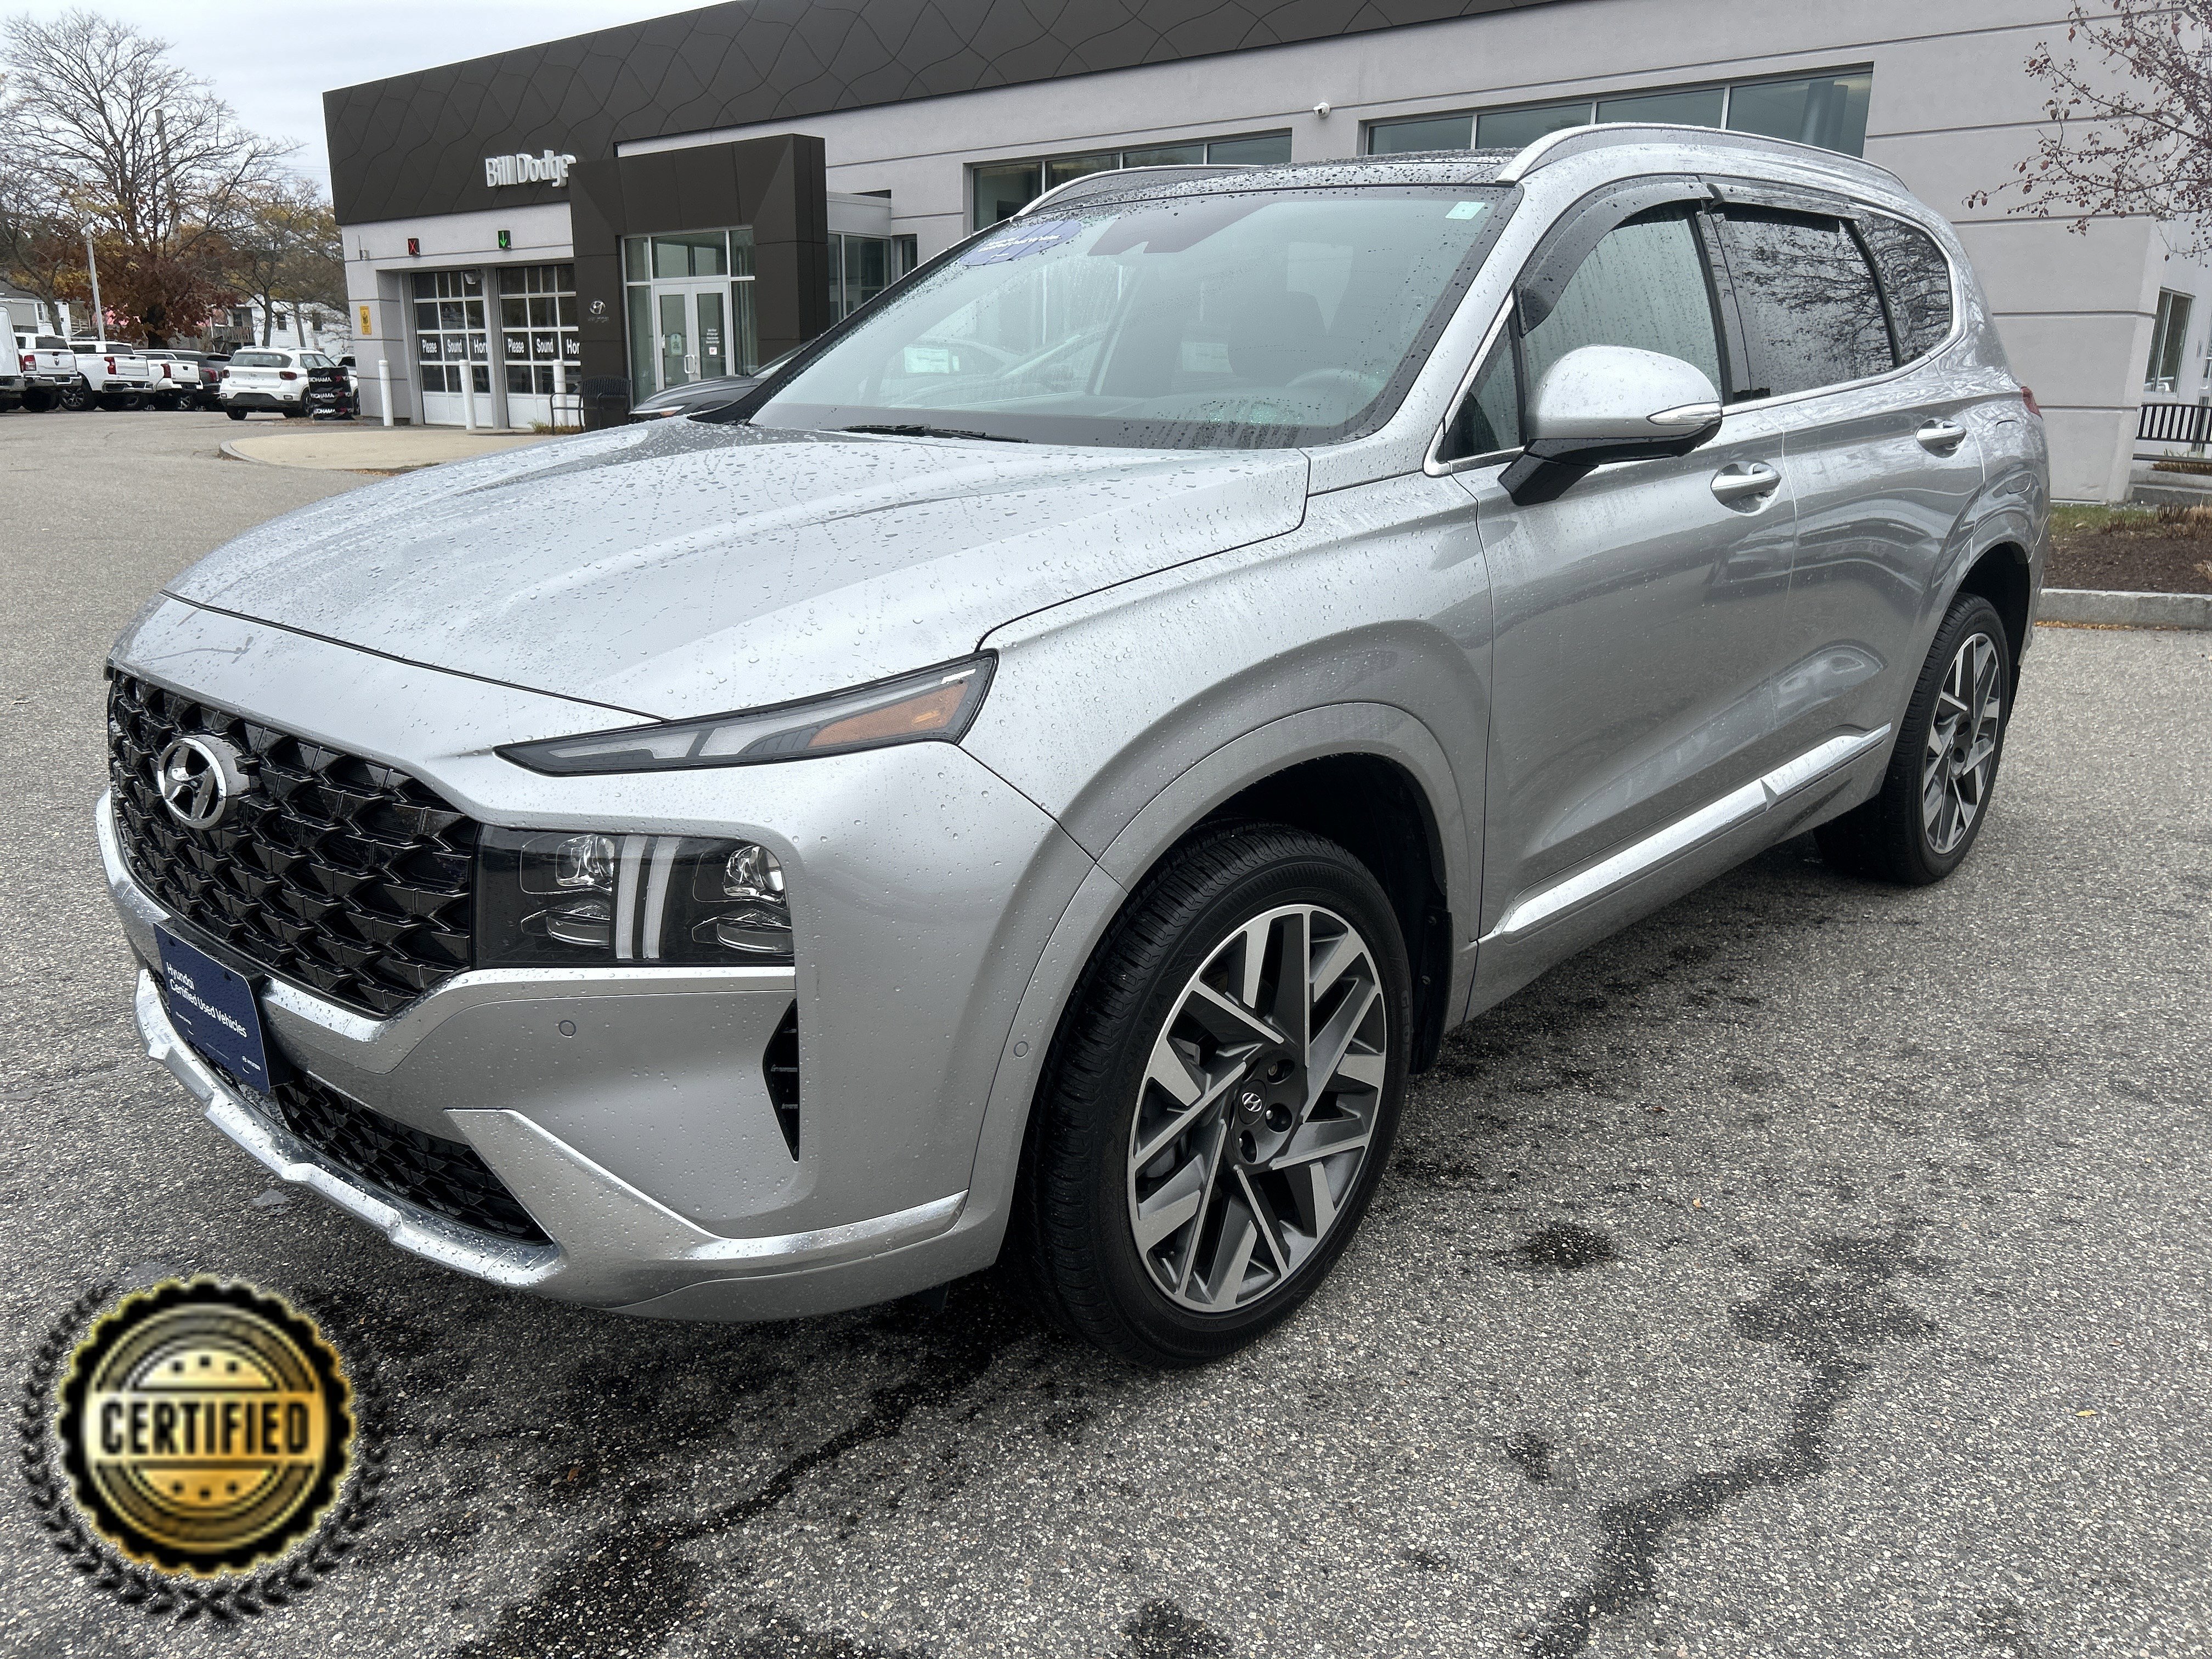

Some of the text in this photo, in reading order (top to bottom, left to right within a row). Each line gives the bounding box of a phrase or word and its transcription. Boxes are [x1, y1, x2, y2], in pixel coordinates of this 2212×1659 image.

[486, 150, 576, 188] Bill Dodge
[422, 338, 437, 353] Please
[447, 338, 462, 353] Sound
[507, 337, 580, 354] Please Sound Hor
[166, 961, 195, 990] Hyundai
[170, 978, 199, 1007] Certified
[197, 996, 217, 1019] Used
[215, 1008, 247, 1038] Vehicles
